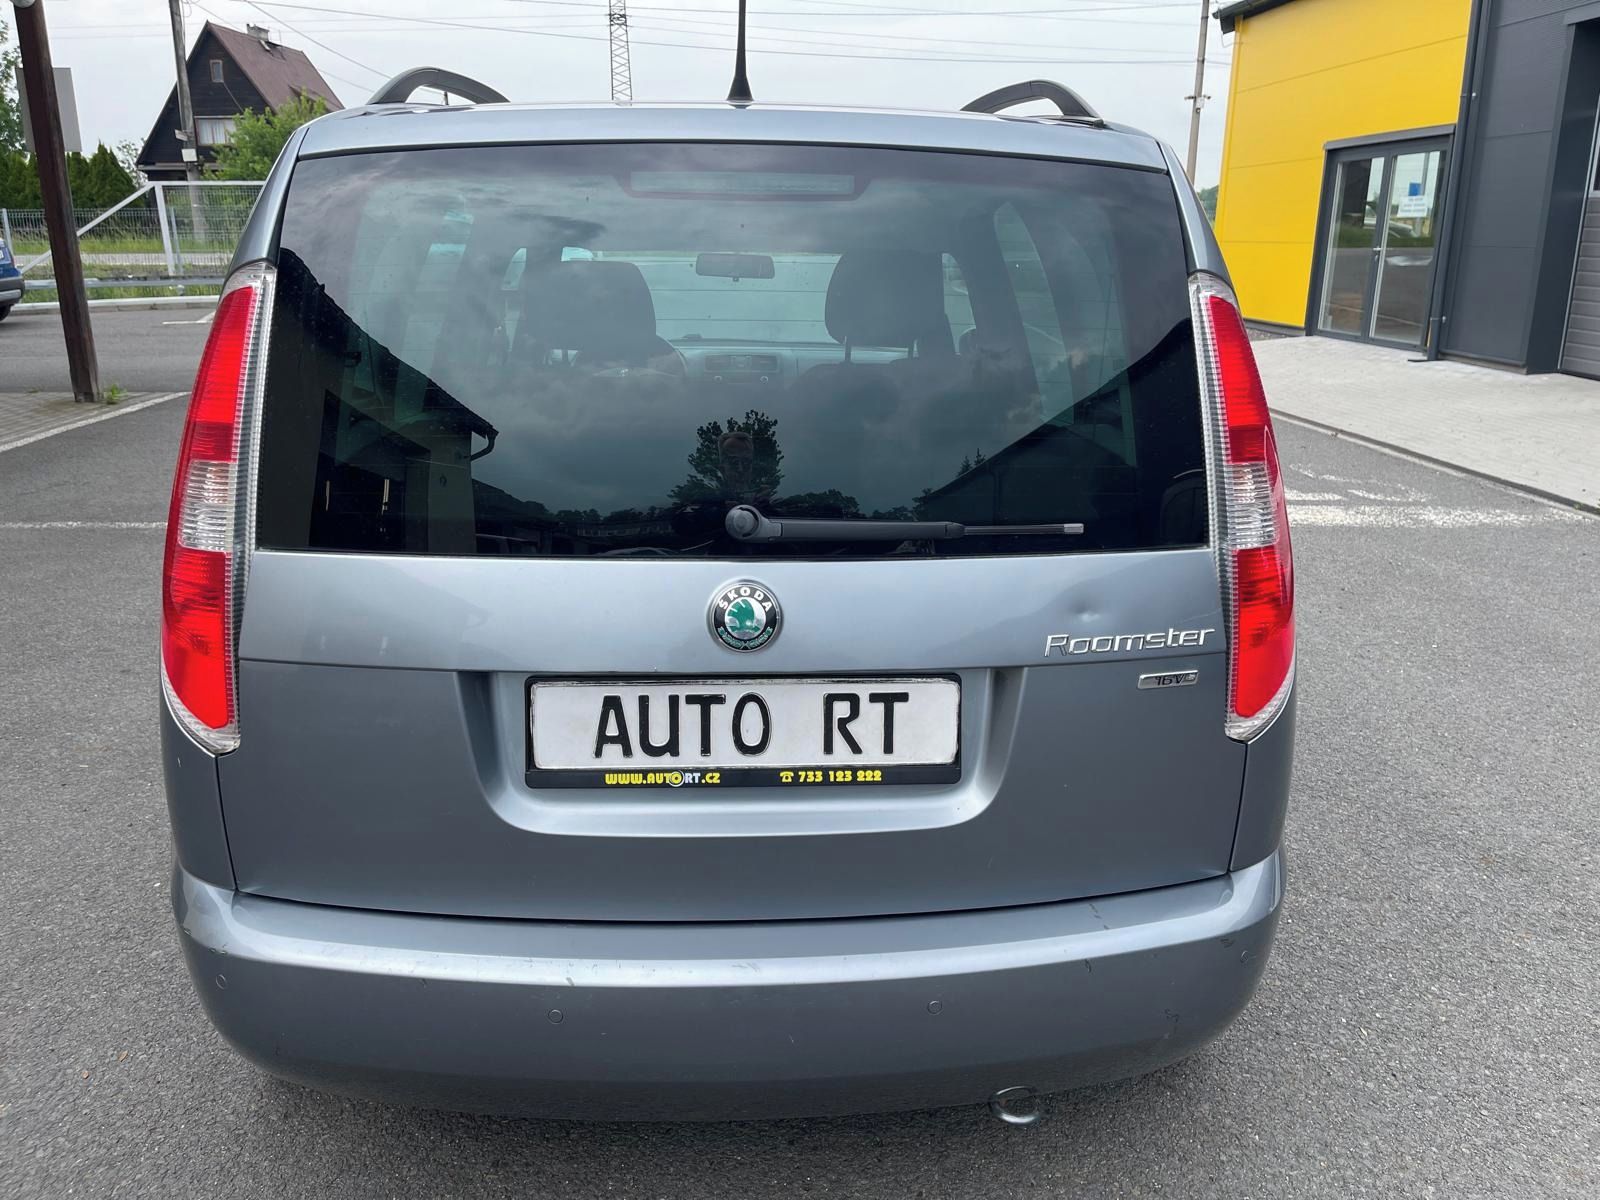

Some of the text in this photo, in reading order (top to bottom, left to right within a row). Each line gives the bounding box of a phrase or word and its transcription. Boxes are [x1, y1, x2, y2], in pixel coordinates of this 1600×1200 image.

[718, 586, 773, 612] SKODA
[1044, 627, 1216, 657] Roomster
[1154, 673, 1185, 687] 16V
[593, 691, 910, 758] AUTO RT
[798, 769, 882, 783] 733 123 222
